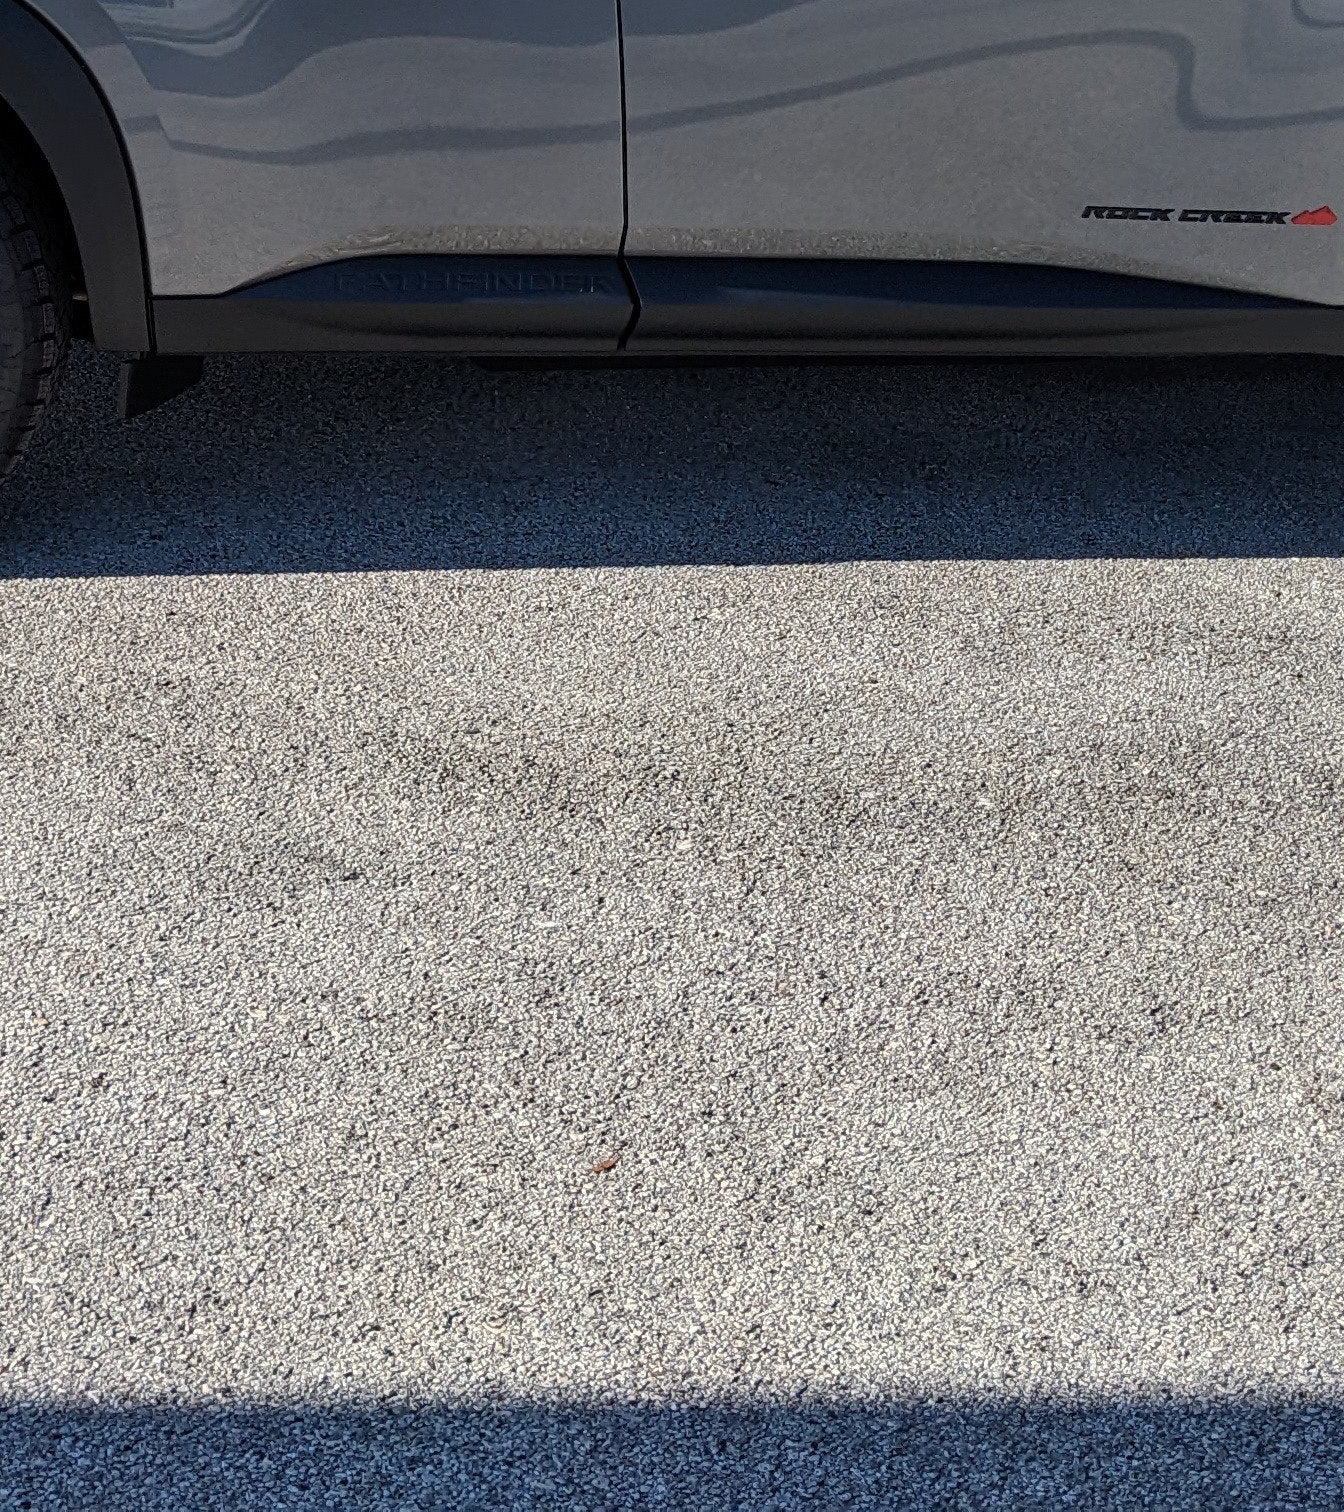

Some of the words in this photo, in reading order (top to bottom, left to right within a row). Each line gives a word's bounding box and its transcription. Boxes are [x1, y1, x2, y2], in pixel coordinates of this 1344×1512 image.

[1082, 205, 1175, 222] ROCK
[1178, 209, 1291, 225] CREEK
[335, 271, 616, 293] PATHFINDER
